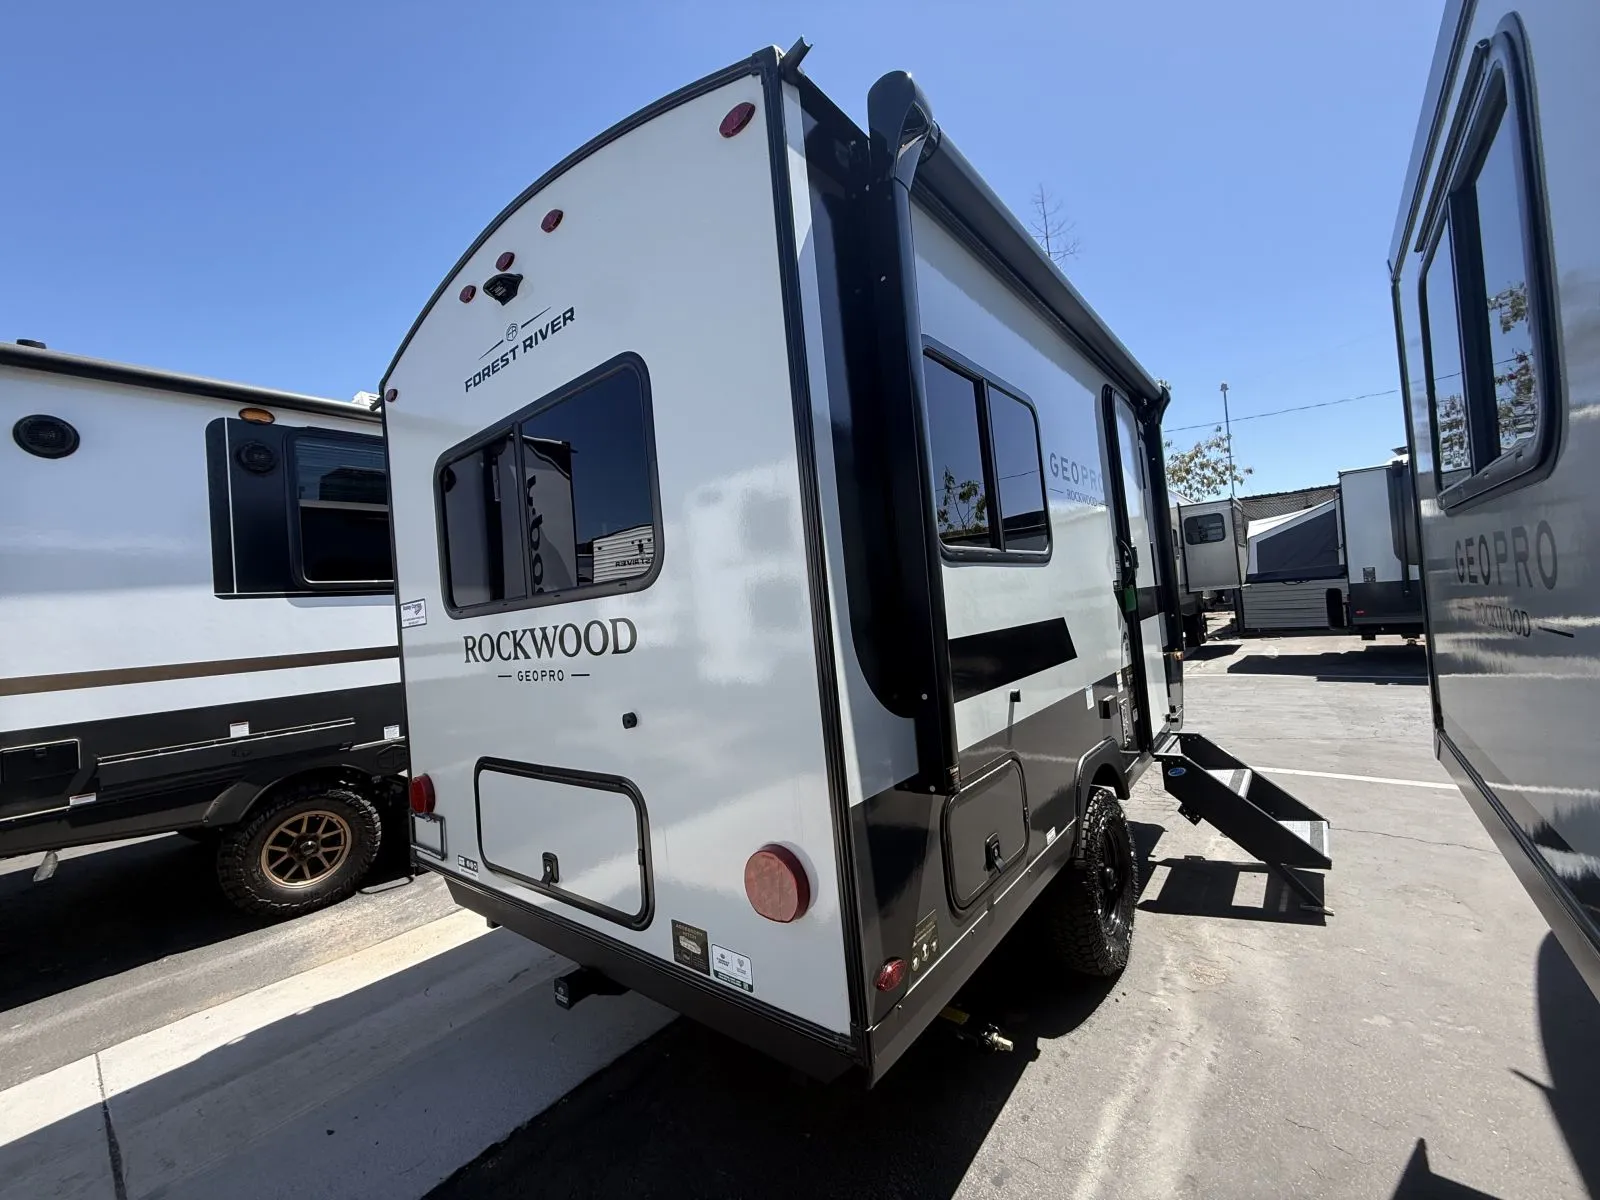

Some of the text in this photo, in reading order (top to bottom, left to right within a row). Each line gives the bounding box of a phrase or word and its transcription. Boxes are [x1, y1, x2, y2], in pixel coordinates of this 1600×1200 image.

[464, 306, 576, 393] FOREST RIVER
[1067, 489, 1098, 506] ROCKWOOD
[1454, 520, 1558, 591] GEOPRO
[463, 617, 638, 663] ROCKWOOD
[1474, 602, 1531, 638] ROCKWOOD
[517, 669, 565, 682] GEOPRO
